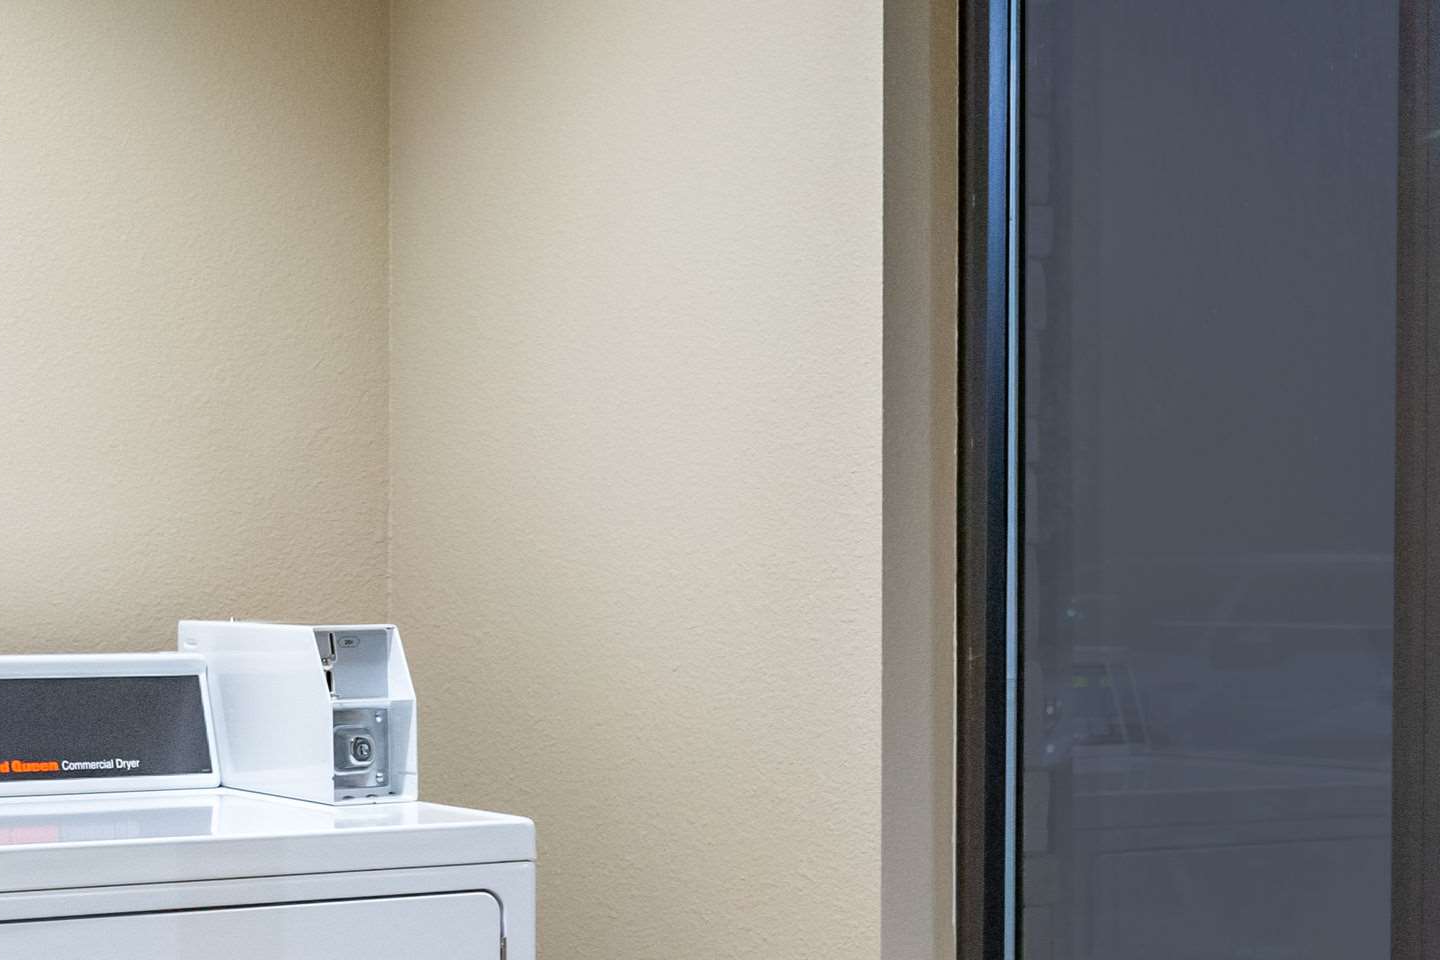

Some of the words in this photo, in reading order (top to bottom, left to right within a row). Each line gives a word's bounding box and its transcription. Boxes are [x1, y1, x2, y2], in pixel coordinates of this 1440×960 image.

[12, 760, 59, 773] Queen
[62, 759, 113, 771] Commercial
[115, 758, 140, 770] Dryer
